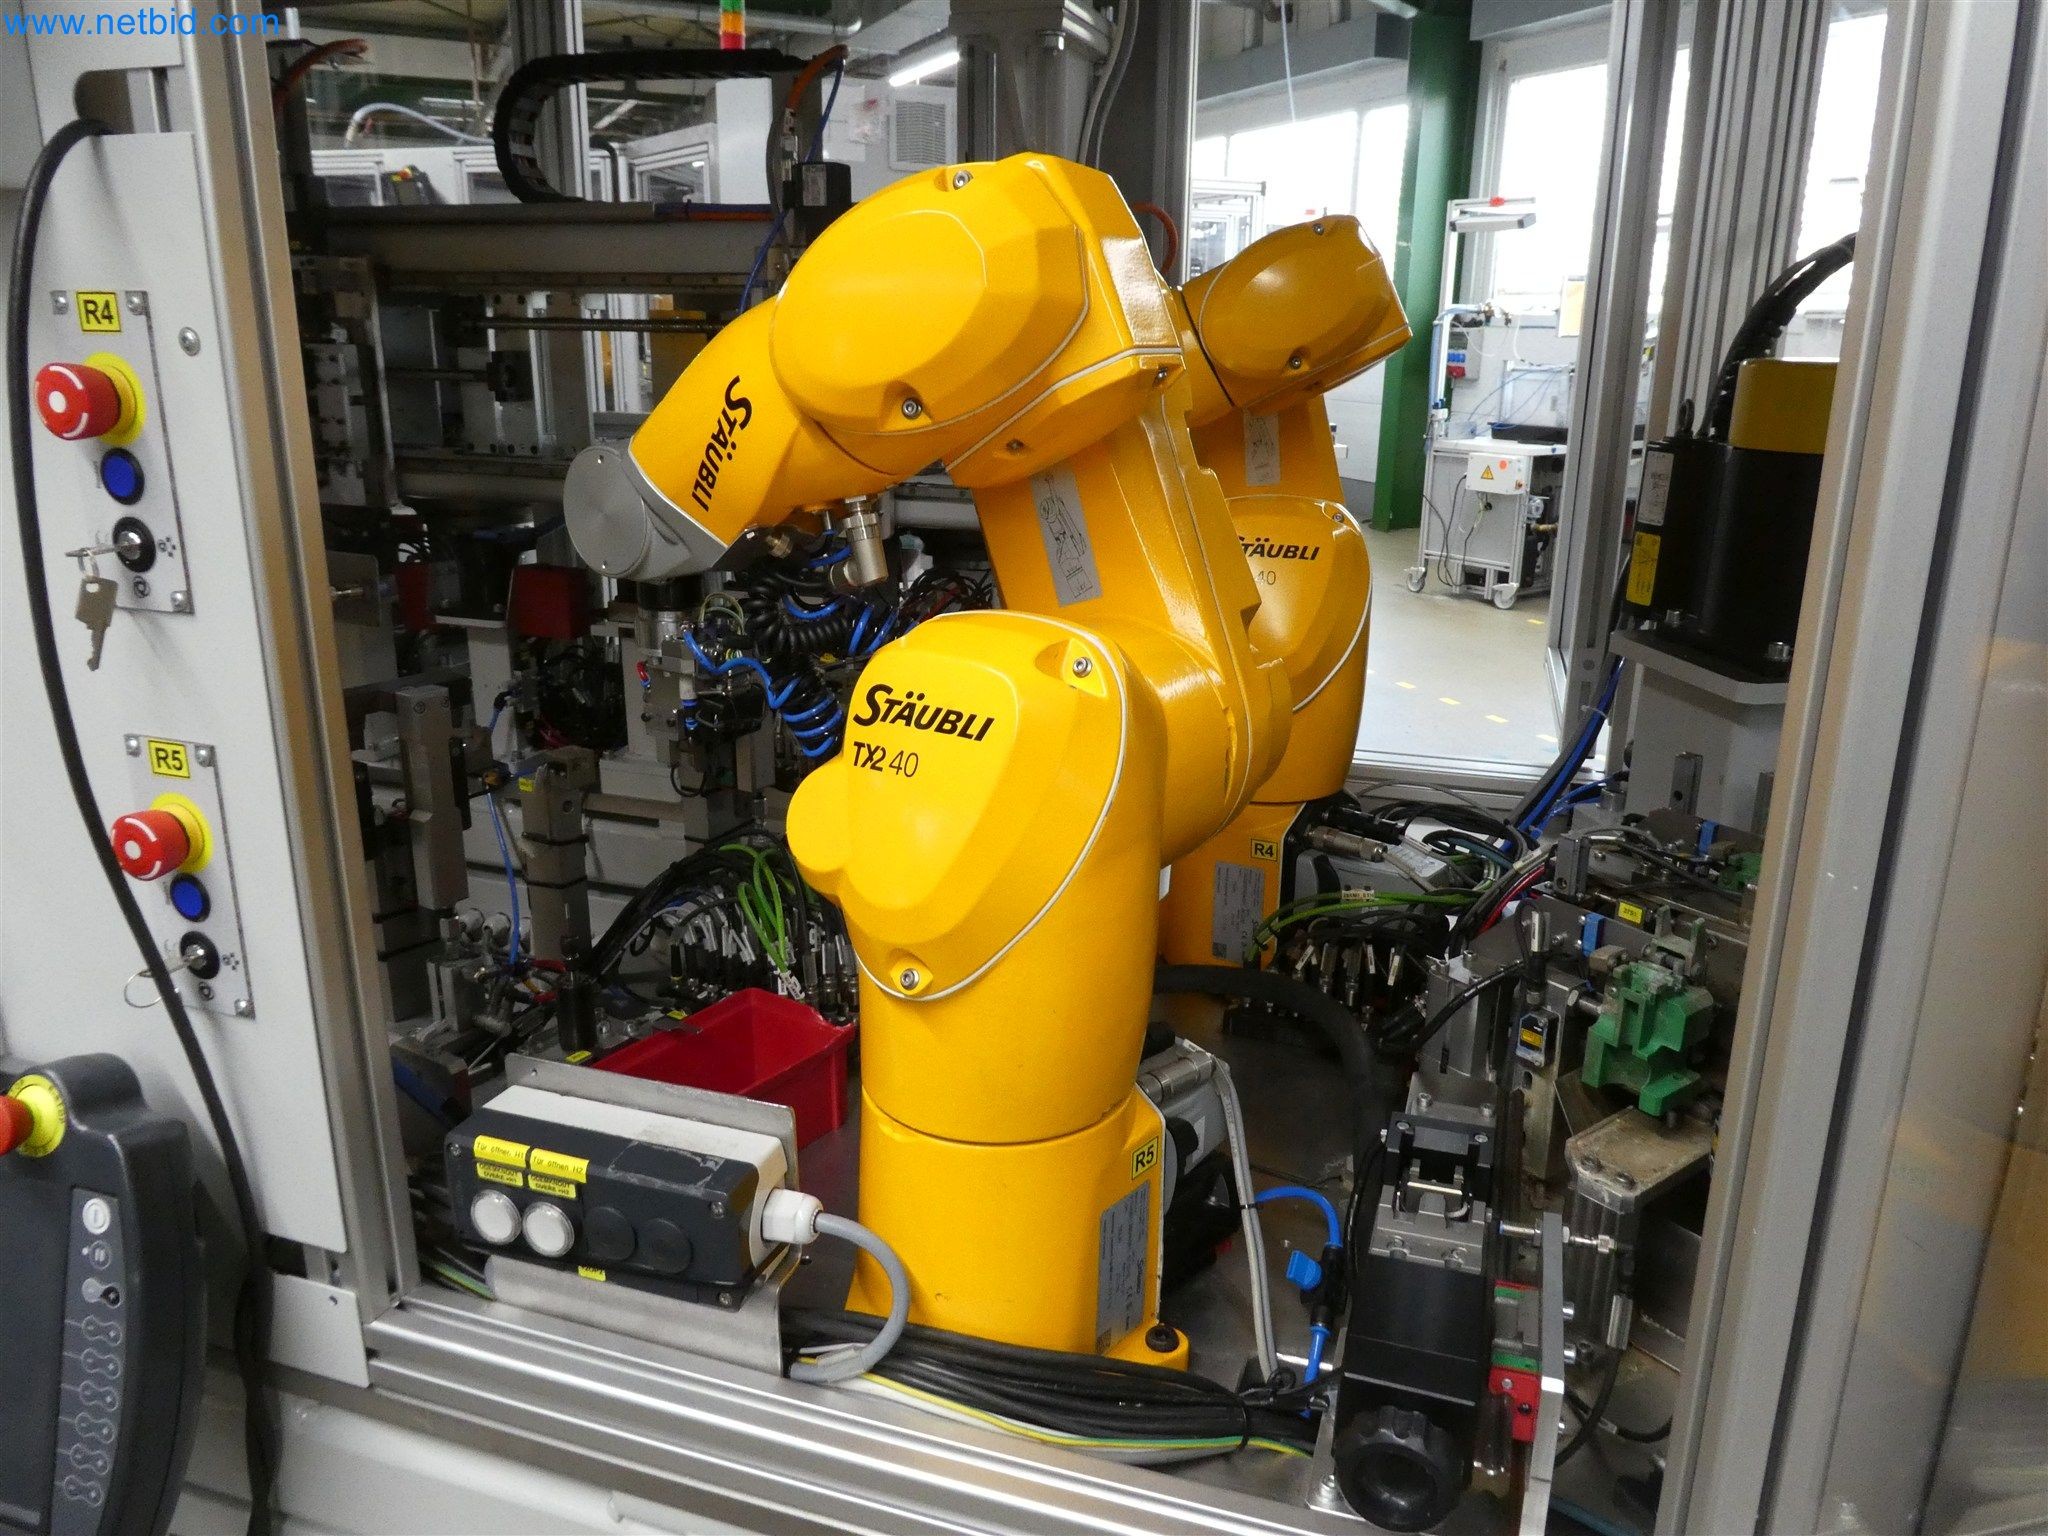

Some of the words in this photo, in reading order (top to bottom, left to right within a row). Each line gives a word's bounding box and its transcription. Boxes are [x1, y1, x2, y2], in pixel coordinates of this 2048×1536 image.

[83, 299, 114, 324] R4
[692, 375, 753, 512] STÄUBLI
[1238, 536, 1320, 561] TÄUBLI
[853, 683, 995, 742] STÄUBLI
[155, 747, 183, 771] R5
[1254, 843, 1275, 858] R4
[1135, 1144, 1155, 1173] R5
